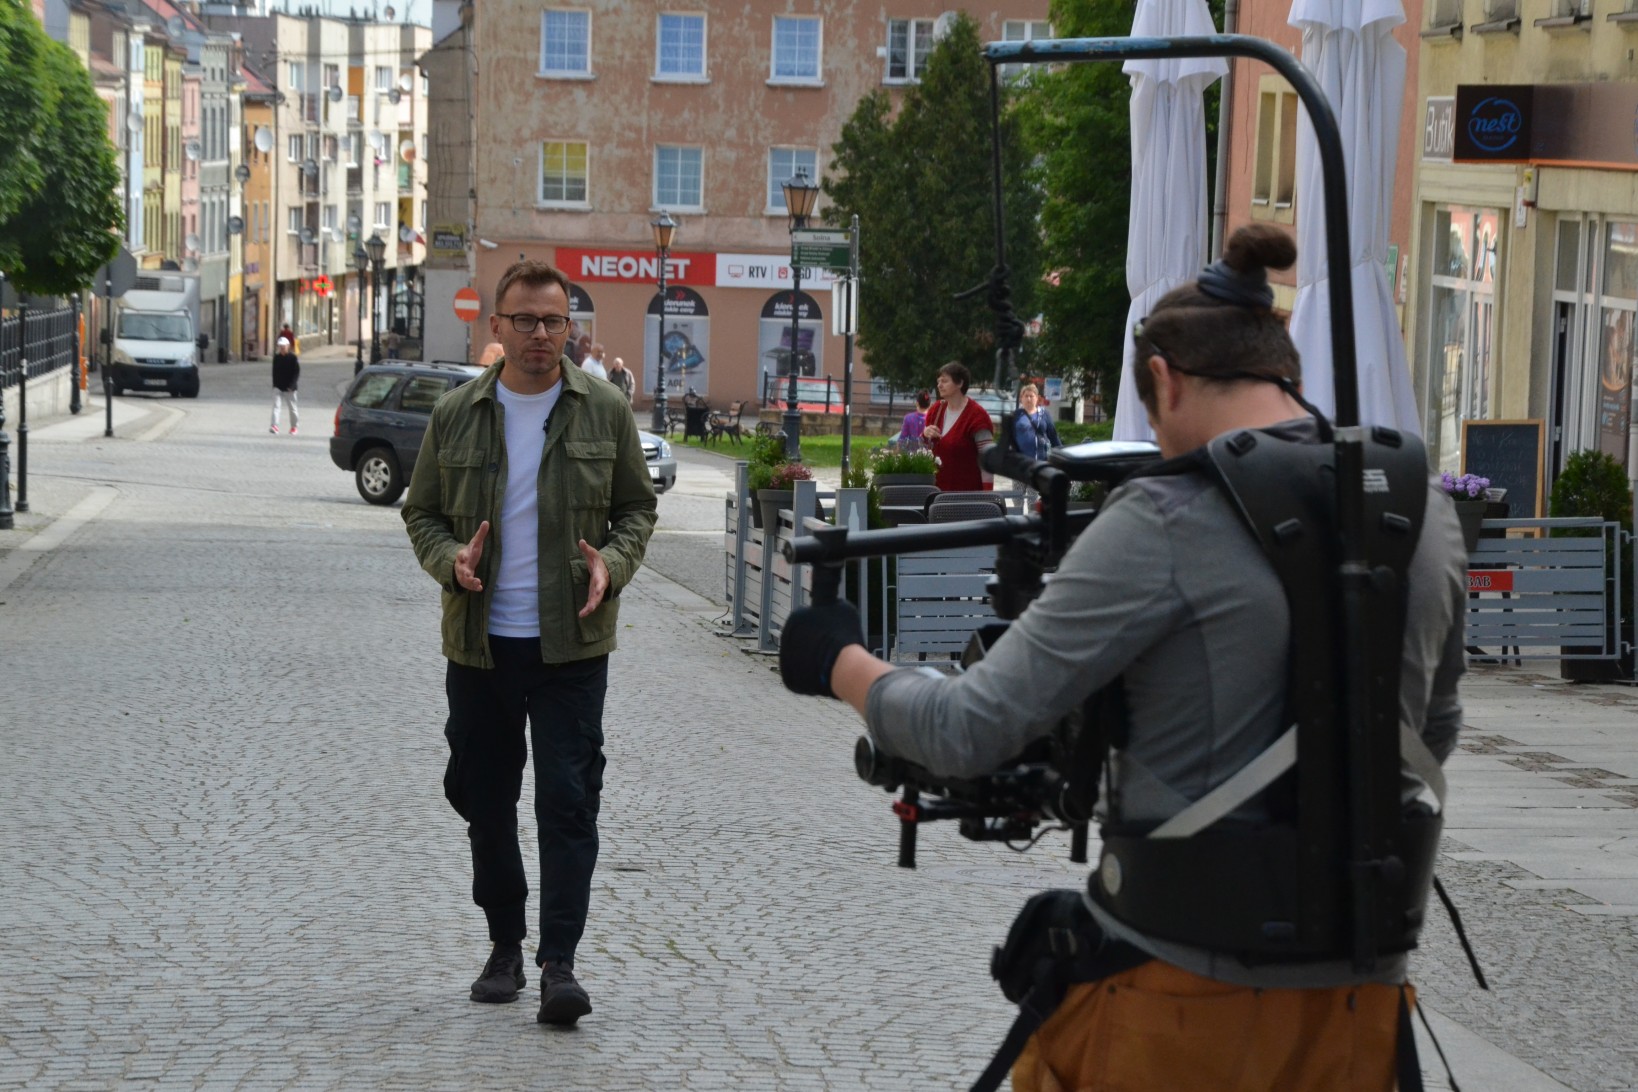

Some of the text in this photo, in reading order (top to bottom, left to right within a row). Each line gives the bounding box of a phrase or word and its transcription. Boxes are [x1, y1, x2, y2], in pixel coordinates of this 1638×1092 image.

[1425, 106, 1453, 151] Butik
[1474, 112, 1519, 133] nest
[582, 256, 690, 279] NEONET
[749, 266, 811, 279] RTV GD
[774, 302, 809, 311] kieruek
